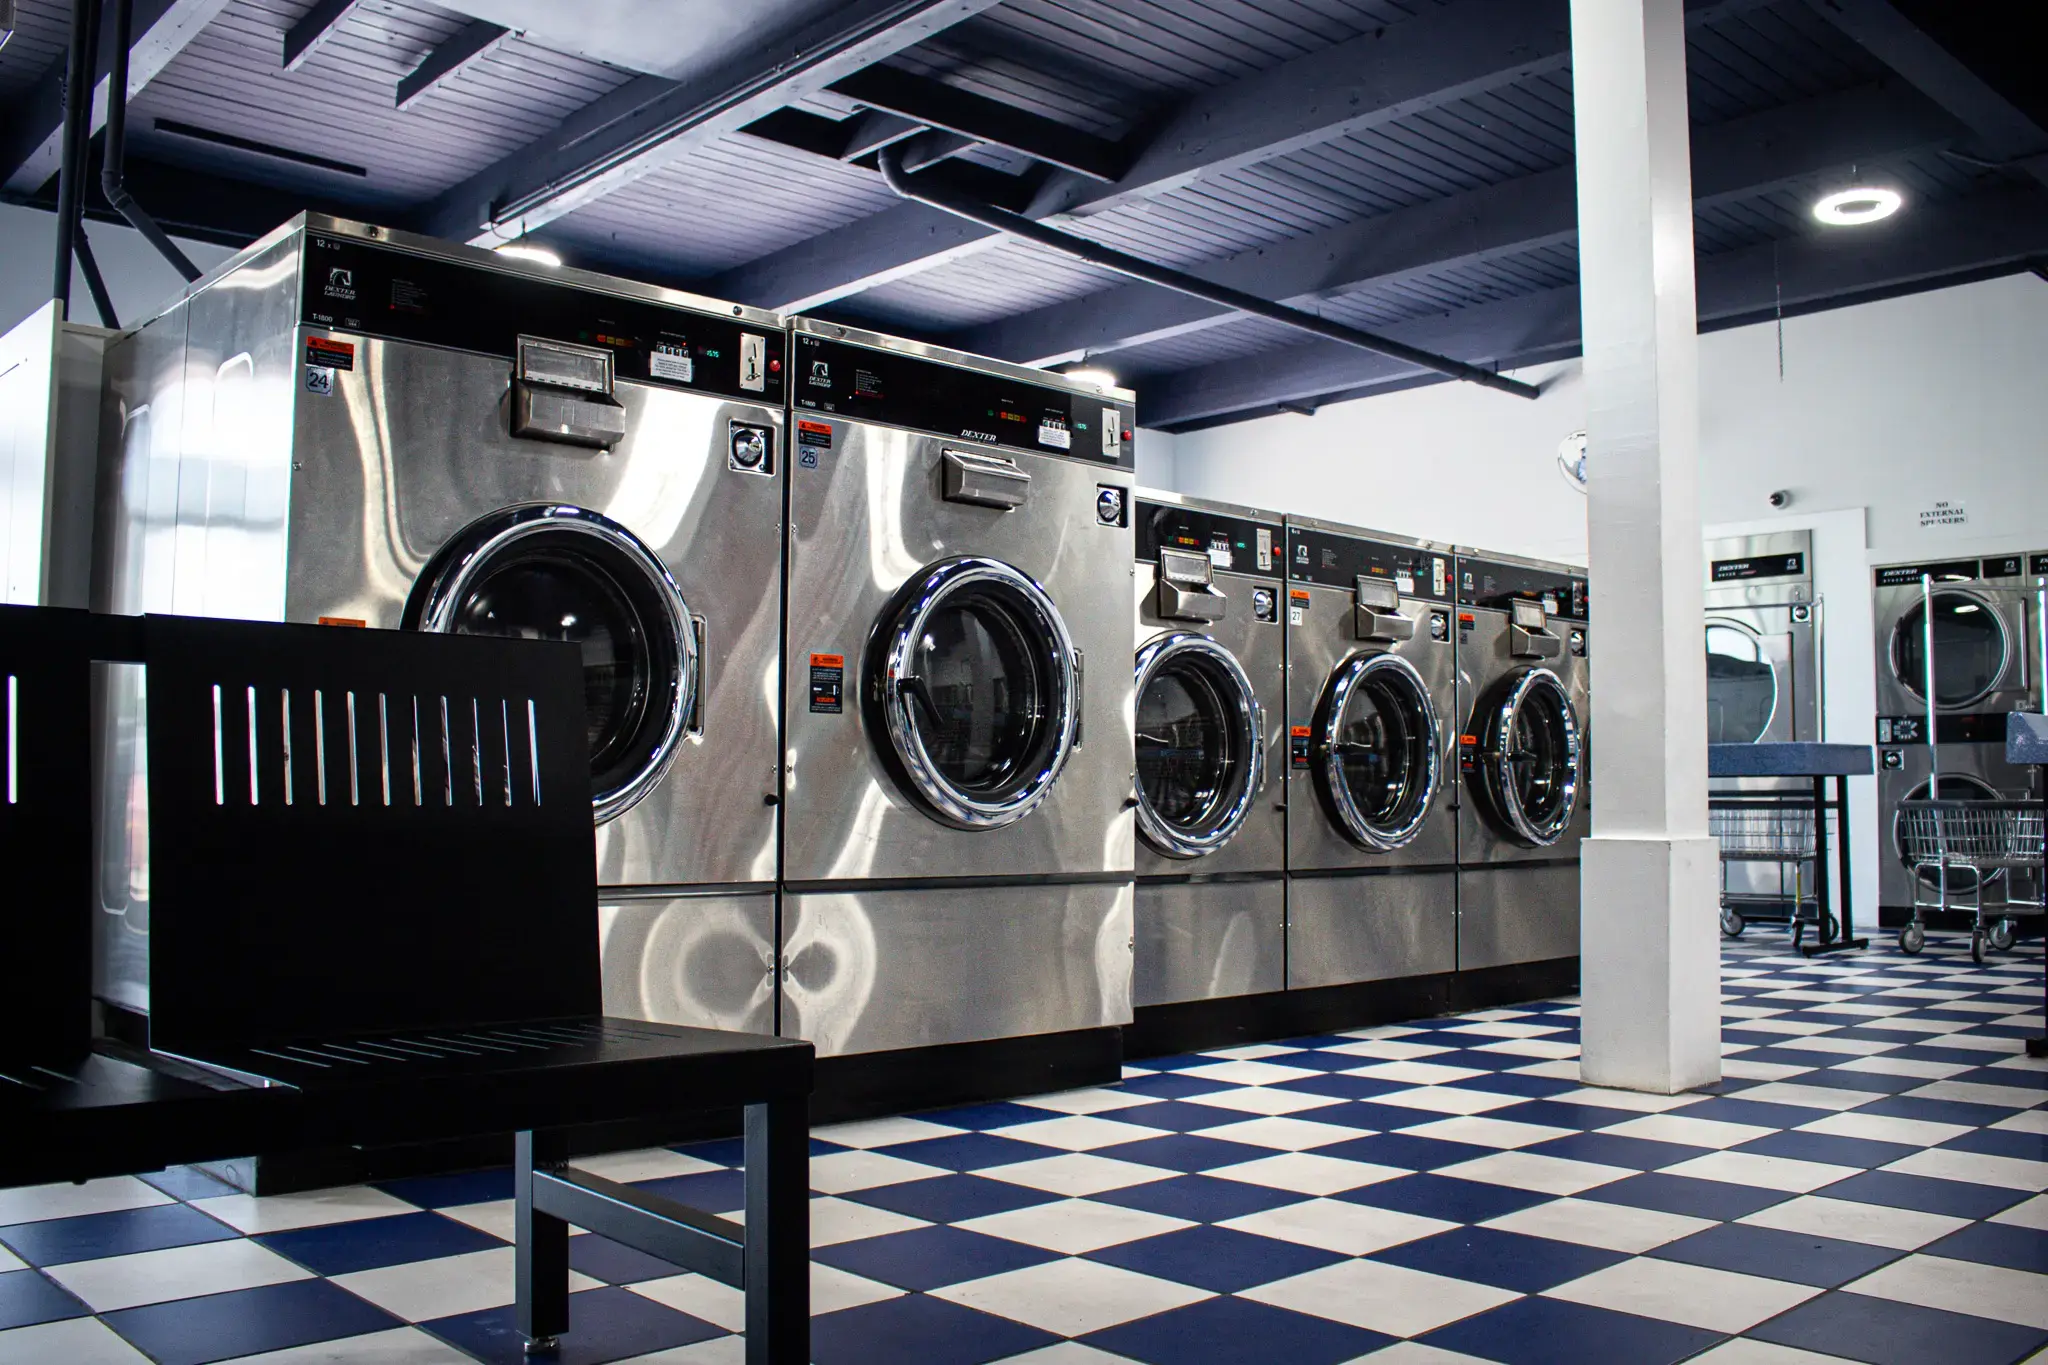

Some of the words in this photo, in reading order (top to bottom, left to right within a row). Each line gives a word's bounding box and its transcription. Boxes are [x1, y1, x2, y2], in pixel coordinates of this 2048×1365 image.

[316, 239, 325, 248] 12
[324, 285, 356, 296] DEXTER
[802, 337, 809, 345] 12
[309, 372, 329, 389] 24
[809, 375, 831, 384] DEXTER
[960, 429, 997, 442] DEXTER
[801, 450, 816, 465] 25
[1920, 508, 1964, 518] EXTERNAL
[1920, 517, 1965, 526] SPEAKERS
[1718, 563, 1750, 571] DEXTER
[1883, 568, 1918, 577] DEXTER
[1292, 611, 1301, 621] 27
